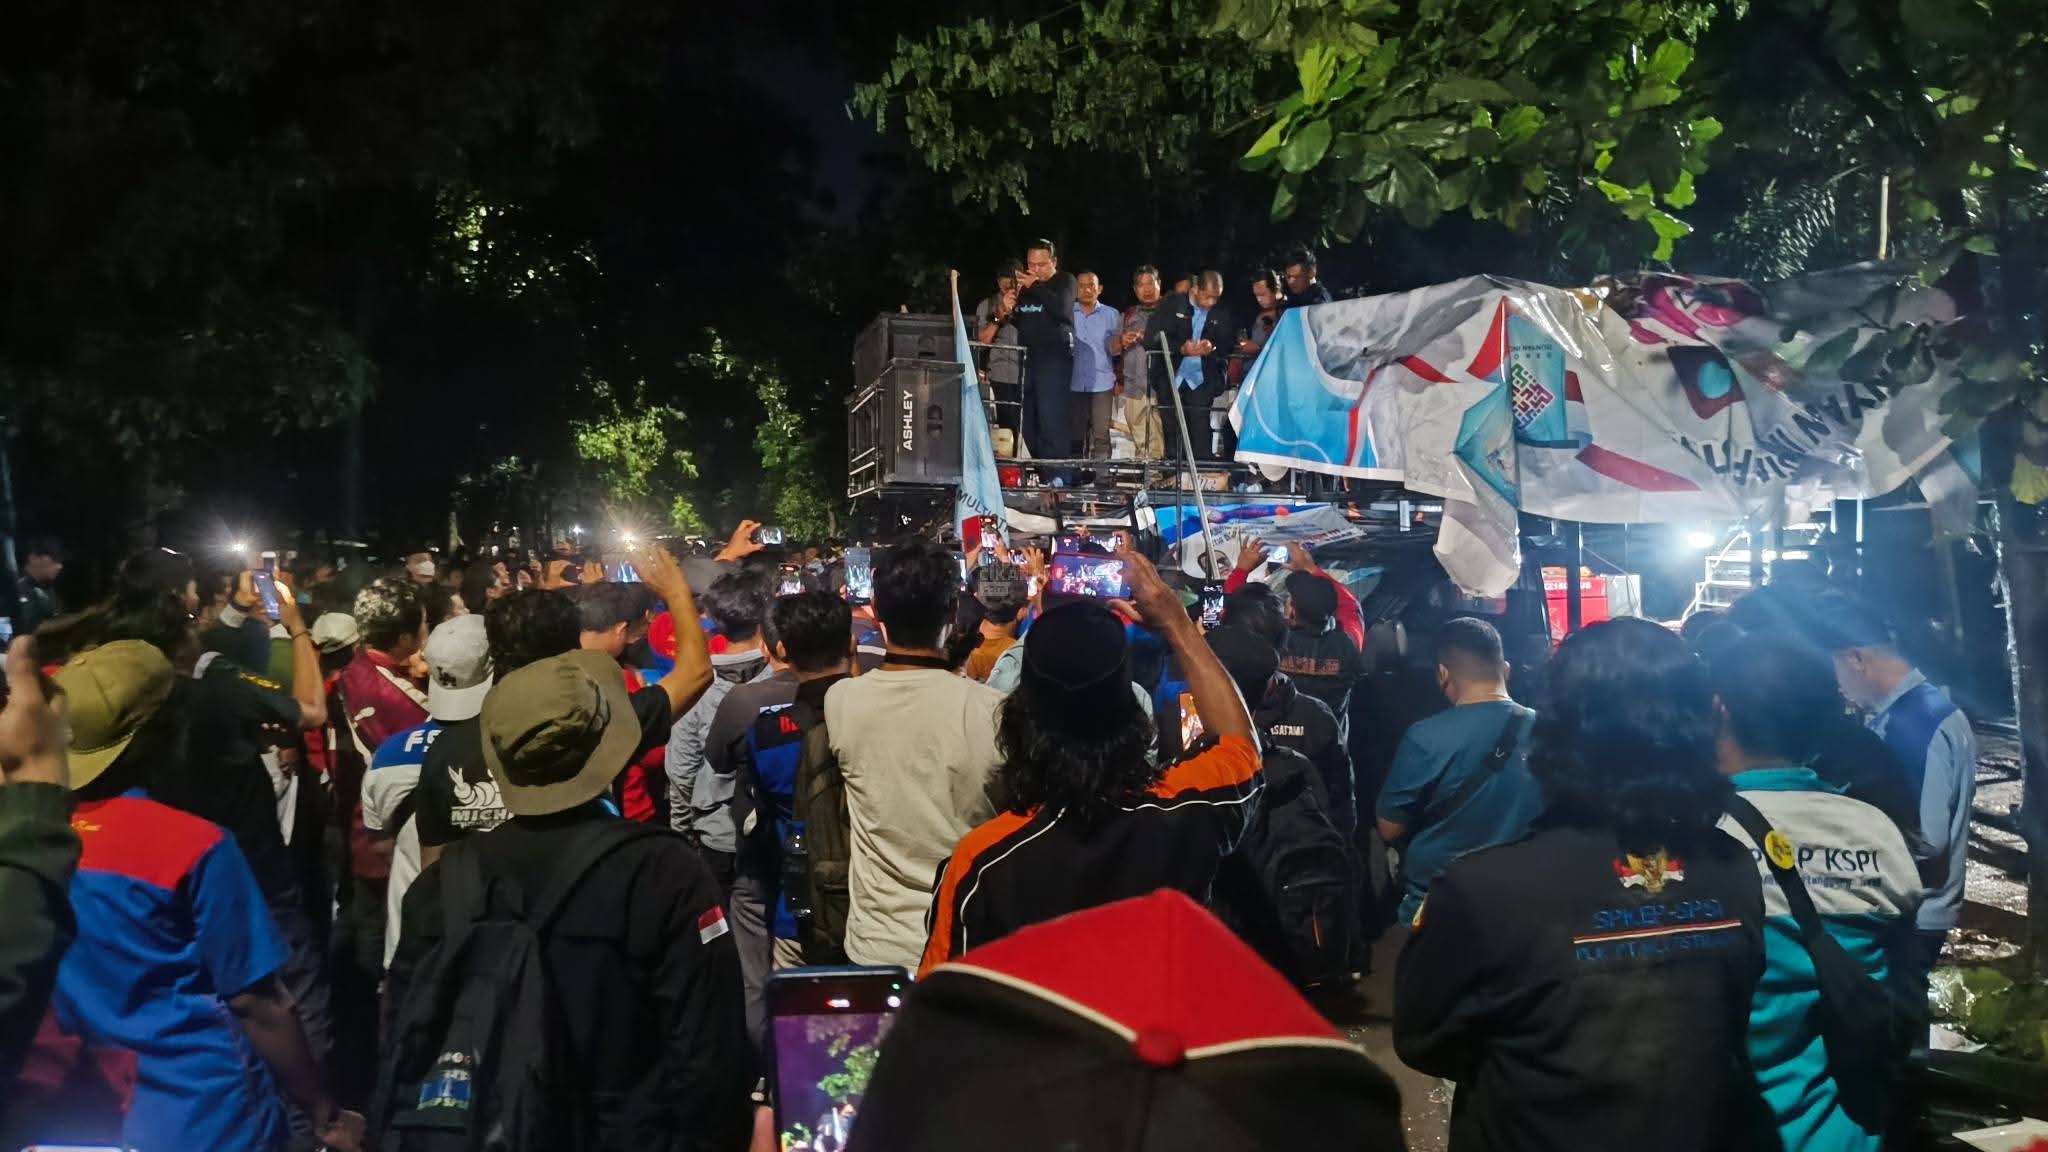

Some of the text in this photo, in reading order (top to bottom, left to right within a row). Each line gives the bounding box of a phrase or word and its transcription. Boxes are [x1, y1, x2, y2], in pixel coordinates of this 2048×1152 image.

[903, 390, 913, 451] ASHLEY
[451, 807, 515, 822] MICH
[1825, 847, 1879, 872] KSPI
